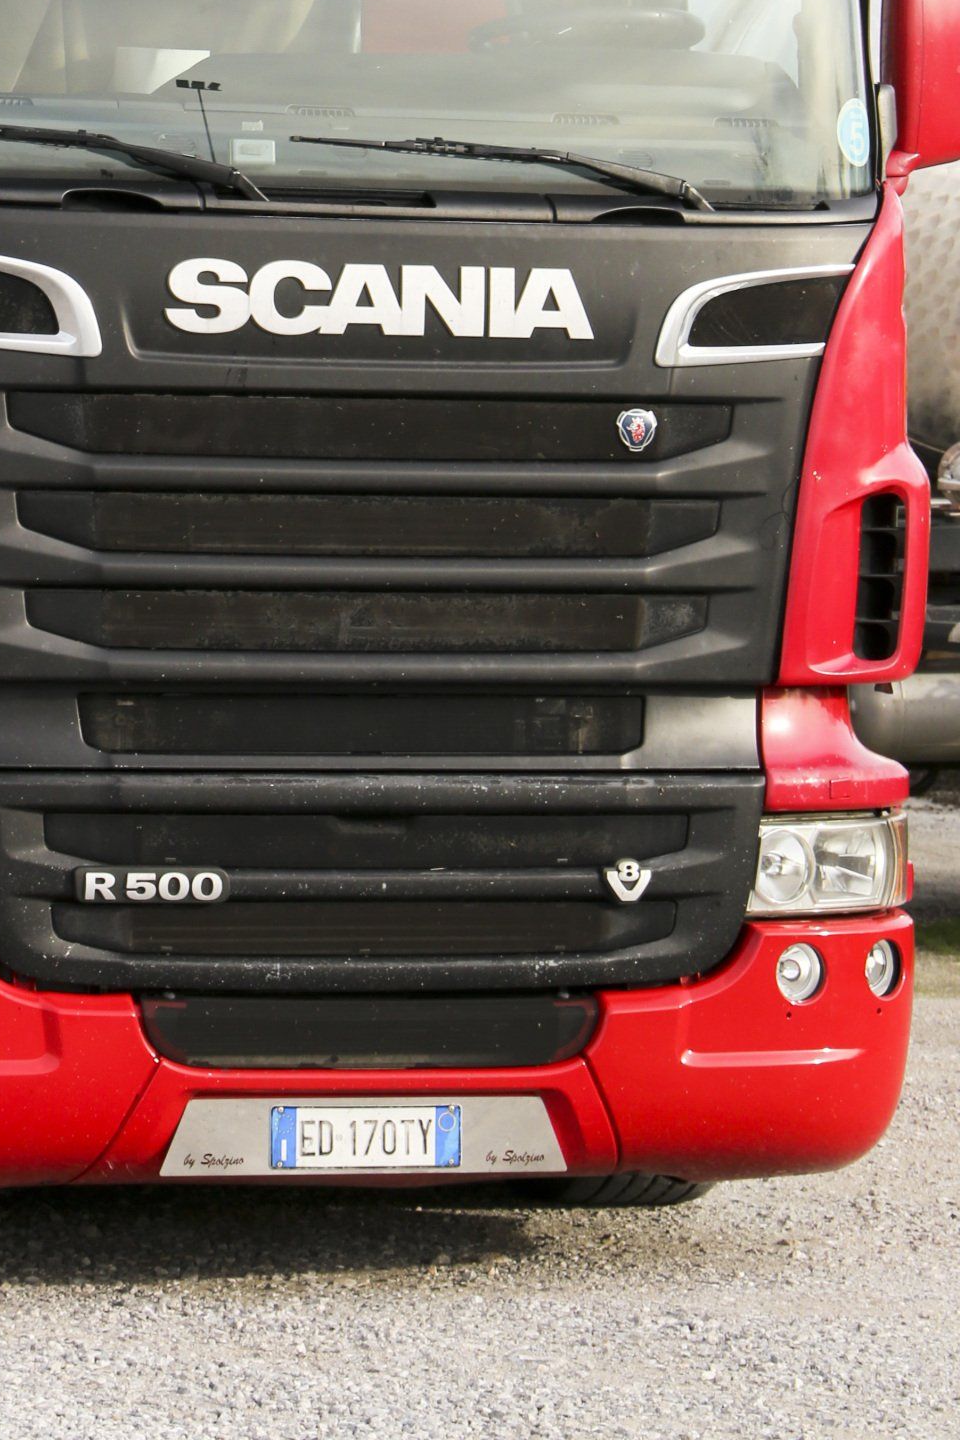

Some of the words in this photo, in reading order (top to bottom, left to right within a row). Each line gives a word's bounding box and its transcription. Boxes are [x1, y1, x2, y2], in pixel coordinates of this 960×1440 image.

[164, 257, 594, 340] SCANIA
[84, 872, 116, 901] R
[125, 872, 223, 901] 500
[300, 1120, 333, 1157] ED
[350, 1119, 432, 1156] 170TY
